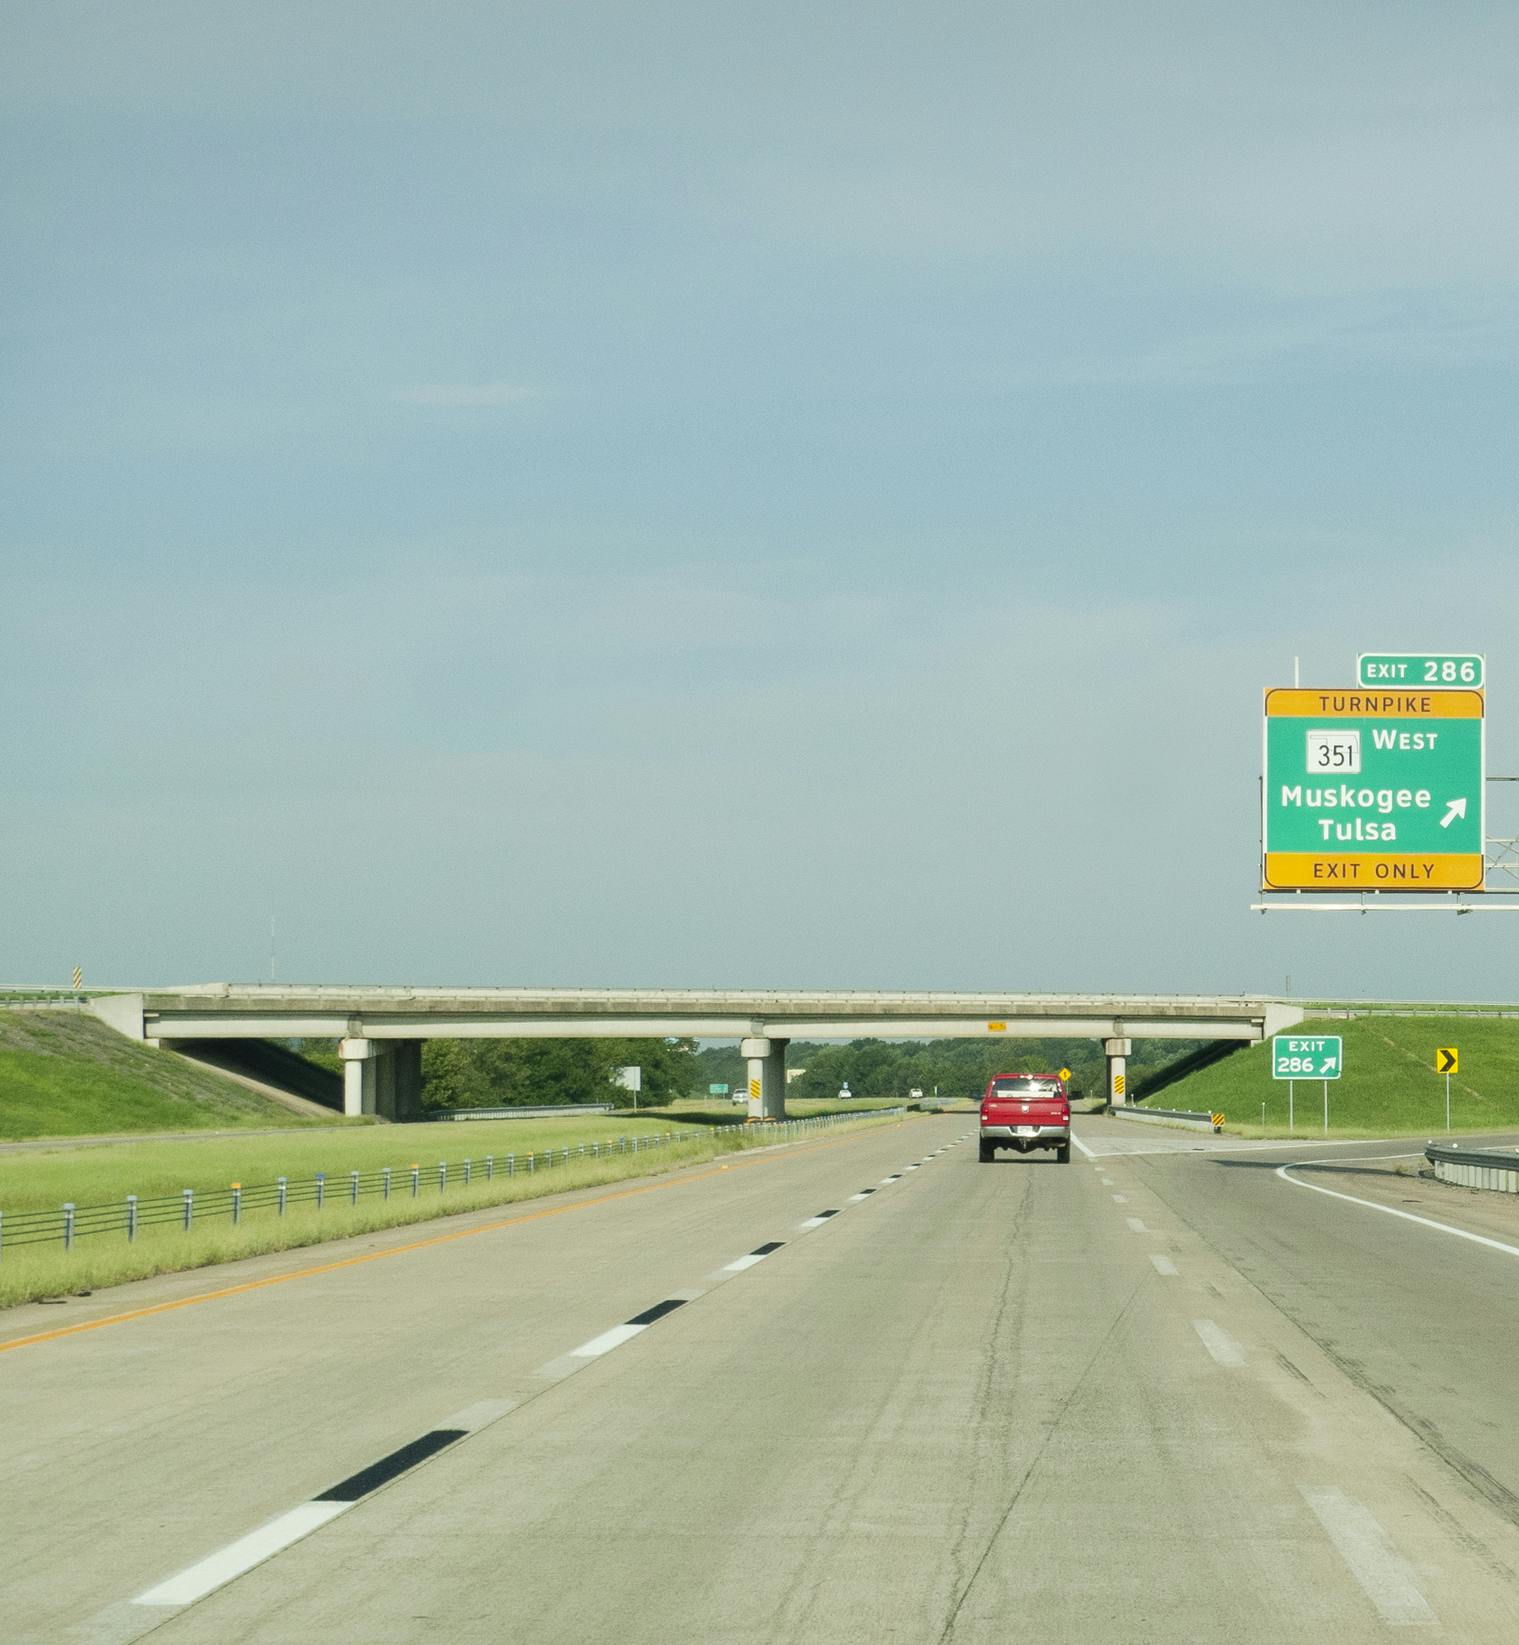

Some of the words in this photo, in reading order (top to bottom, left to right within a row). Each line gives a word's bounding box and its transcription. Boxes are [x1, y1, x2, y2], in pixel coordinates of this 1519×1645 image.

[1367, 664, 1408, 678] EXIT
[1424, 661, 1475, 682] 286
[1318, 696, 1432, 713] TURNPIKE
[1318, 744, 1353, 767] 351
[1372, 729, 1438, 750] WEST
[1281, 784, 1431, 814] Muskogee
[1318, 817, 1397, 841] Tulsa
[1313, 863, 1360, 879] EXIT
[1375, 863, 1435, 879] ONLY
[1288, 1041, 1326, 1052] EXIT
[1277, 1056, 1314, 1073] 286
